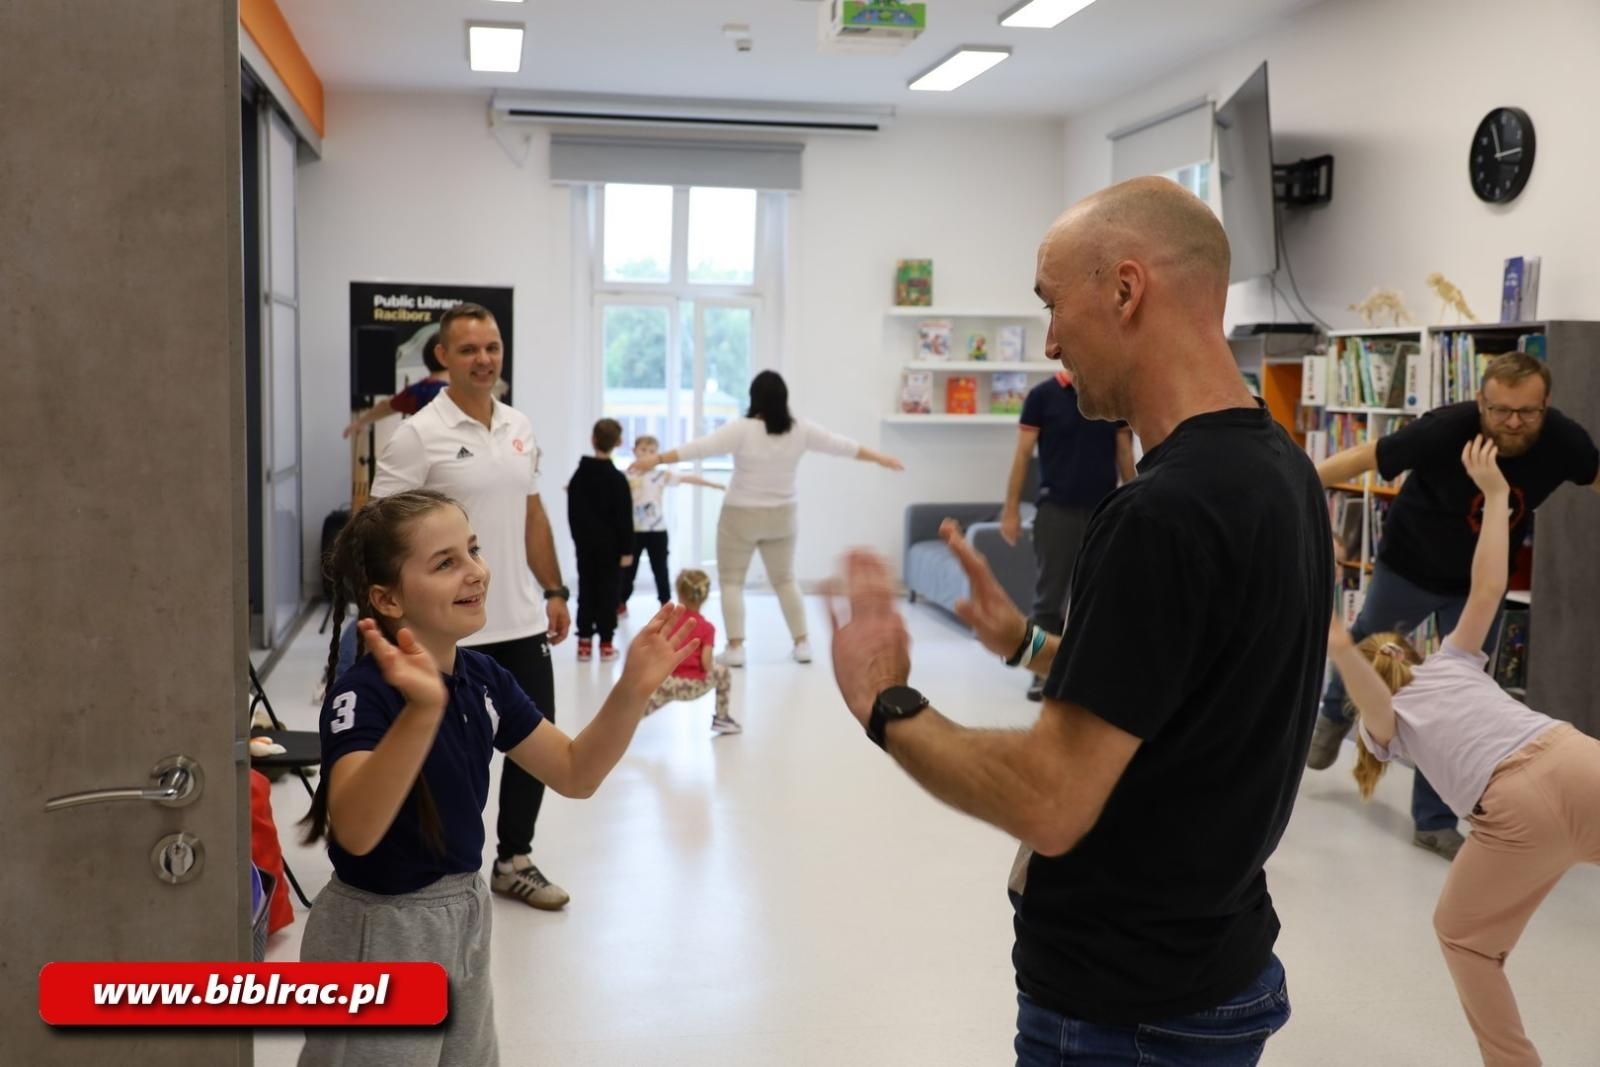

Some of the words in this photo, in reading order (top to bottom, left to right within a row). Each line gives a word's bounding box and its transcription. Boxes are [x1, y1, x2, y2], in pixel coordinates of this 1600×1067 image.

[373, 294, 415, 308] Public
[373, 308, 432, 321] Raciborz
[330, 690, 357, 734] 3
